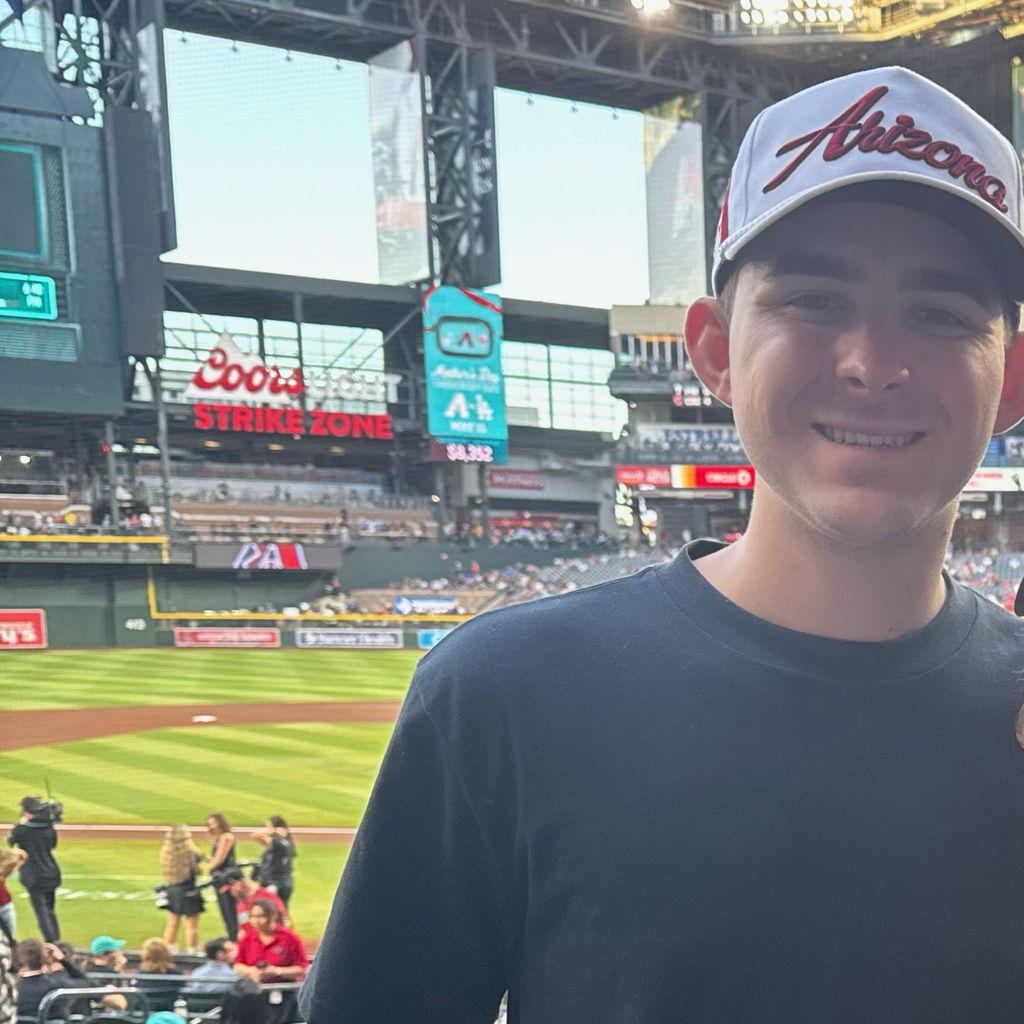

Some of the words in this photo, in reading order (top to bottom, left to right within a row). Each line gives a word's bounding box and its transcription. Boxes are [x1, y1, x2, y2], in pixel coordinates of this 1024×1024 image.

[762, 85, 1008, 213] Arizona
[192, 347, 305, 394] Coors
[194, 404, 305, 434] STRIKE
[309, 409, 394, 439] ZONE
